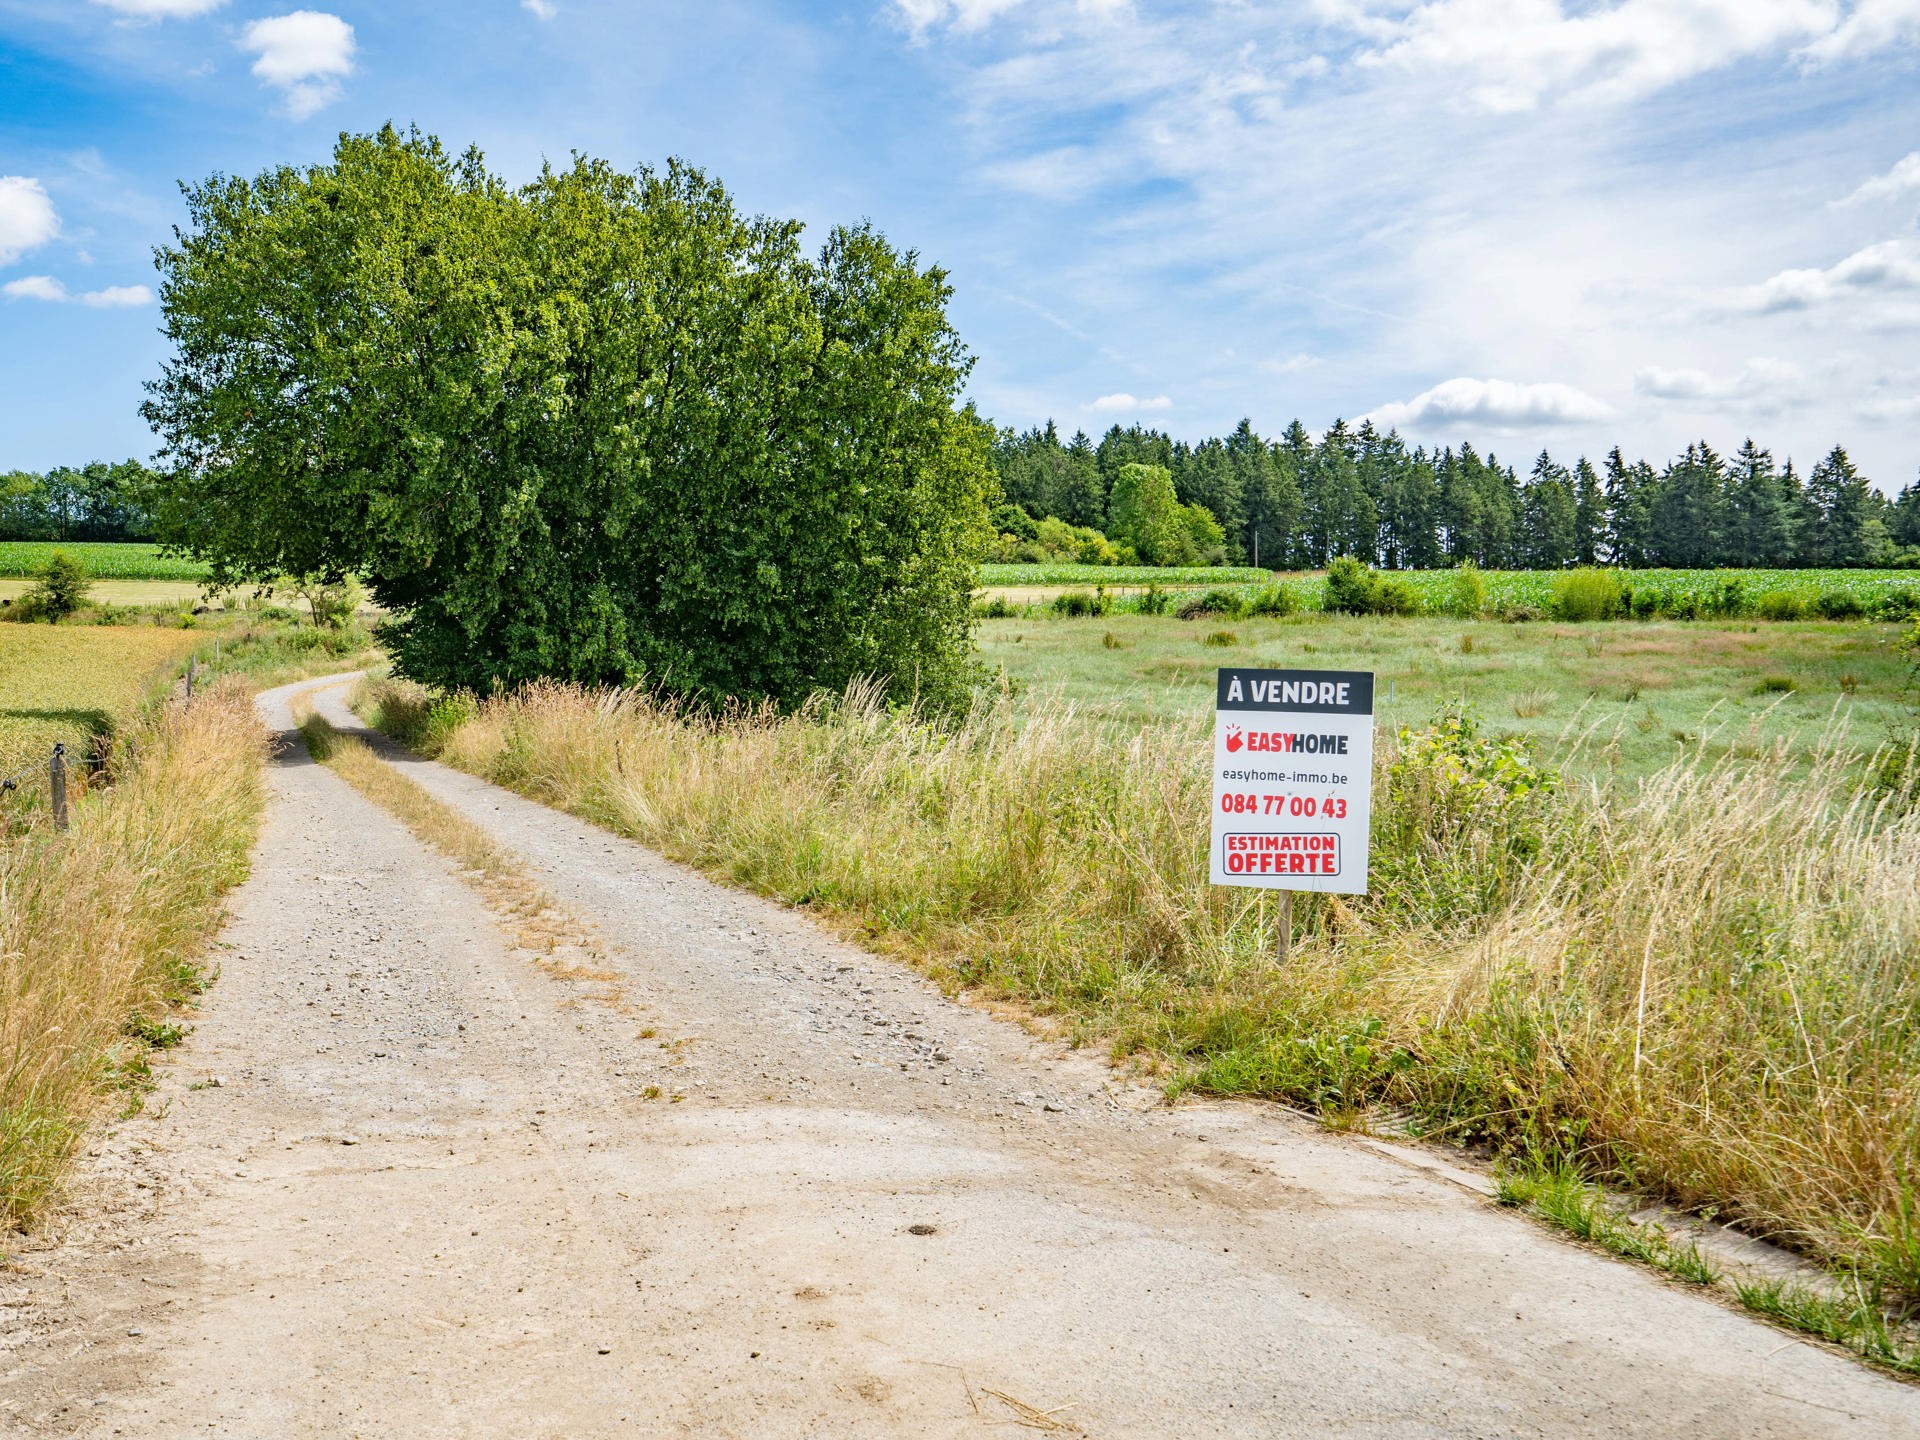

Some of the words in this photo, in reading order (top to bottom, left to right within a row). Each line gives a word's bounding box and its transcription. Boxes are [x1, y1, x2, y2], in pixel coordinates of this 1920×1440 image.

[1227, 676, 1244, 702] À
[1250, 680, 1350, 705] VENDRE
[1247, 732, 1348, 755] EASYHOME
[1222, 769, 1348, 785] easyhome-immo.be
[1221, 793, 1257, 814] 084
[1263, 795, 1285, 815] 77
[1290, 797, 1317, 817] 00
[1322, 798, 1347, 819] 43
[1228, 836, 1335, 851] ESTIMATION
[1228, 853, 1336, 873] OFFERTE
